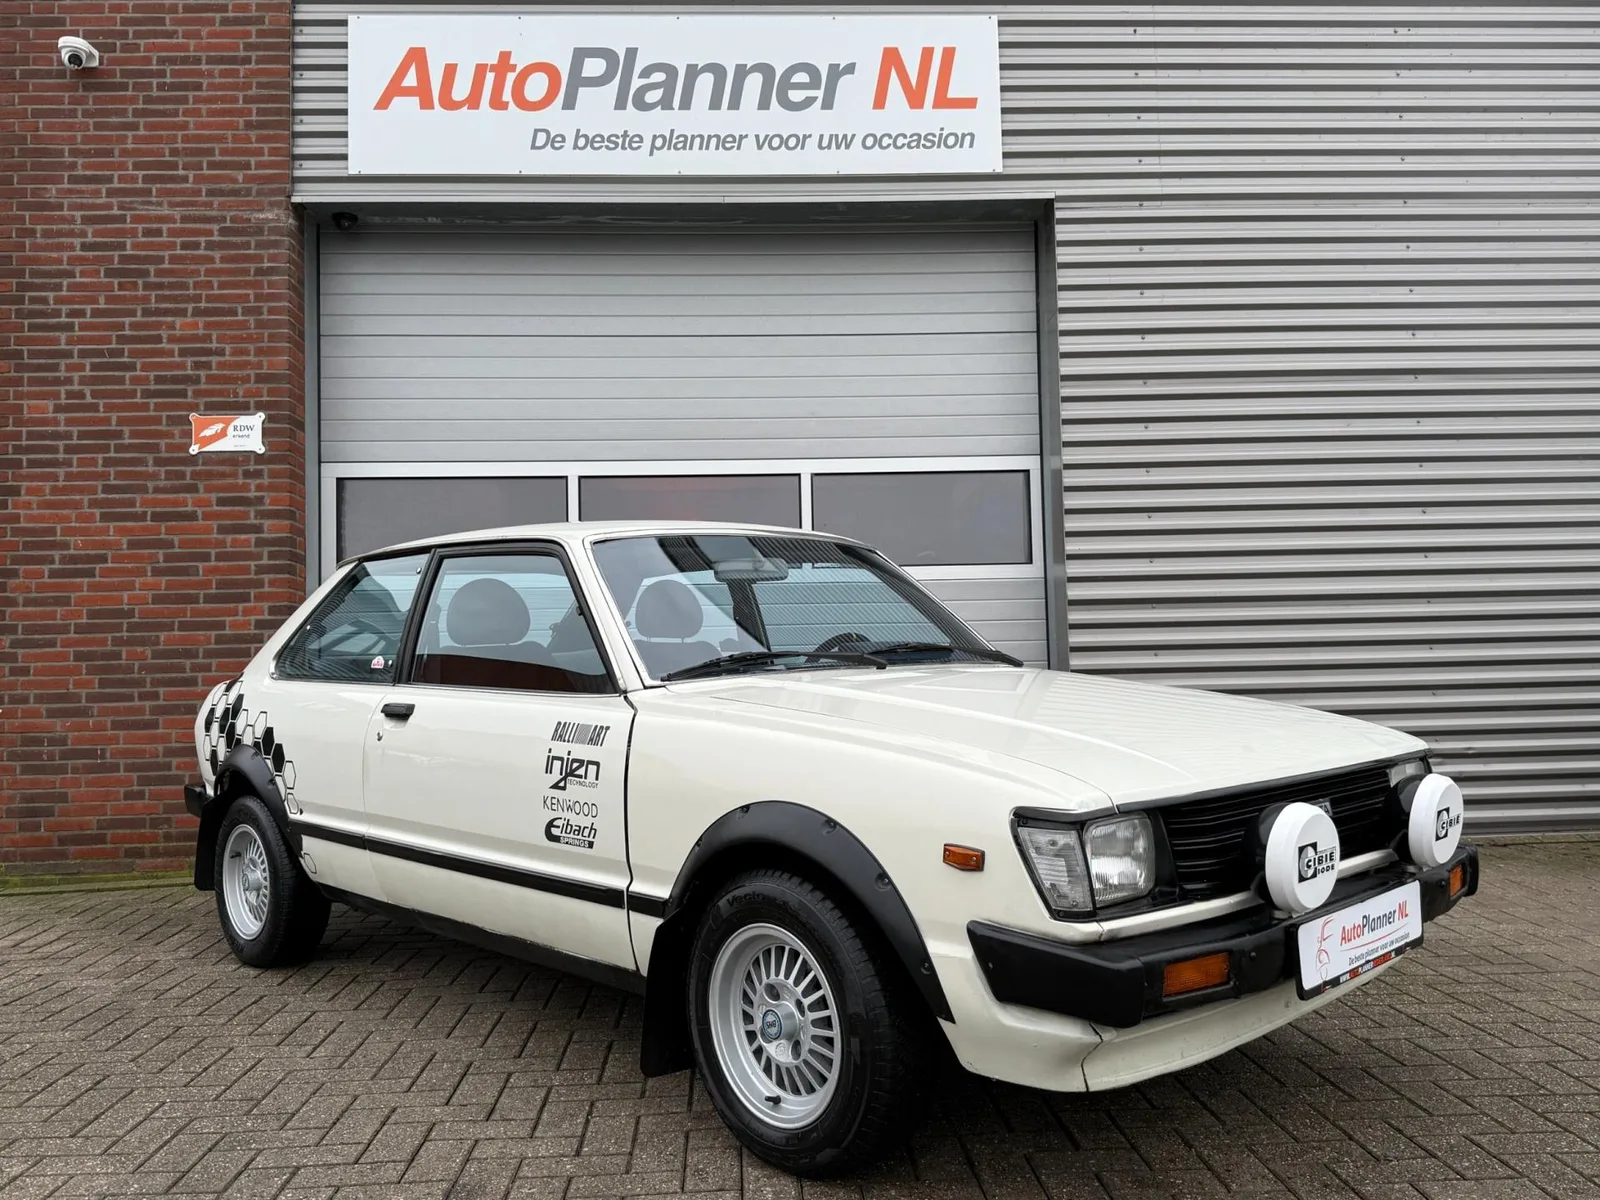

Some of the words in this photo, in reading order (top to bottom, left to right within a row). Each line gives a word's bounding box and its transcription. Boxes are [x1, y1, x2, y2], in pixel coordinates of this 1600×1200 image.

[373, 47, 856, 112] AutoPlanner
[872, 47, 977, 110] NL
[530, 129, 566, 151] De
[573, 129, 643, 151] beste
[648, 129, 748, 157] planner
[754, 133, 813, 151] voor
[817, 133, 857, 151] uw
[861, 128, 976, 151] occasion
[567, 779, 599, 789] TECHNOLOGY
[543, 795, 598, 818] KENWOOD
[545, 817, 597, 841] Eibach
[1441, 815, 1460, 830] CIBIE
[560, 836, 589, 848] SPRINGS
[1305, 851, 1335, 869] CIBIE
[1317, 863, 1335, 874] IODE
[1340, 908, 1396, 946] AutoPlanner
[1398, 900, 1409, 920] NL
